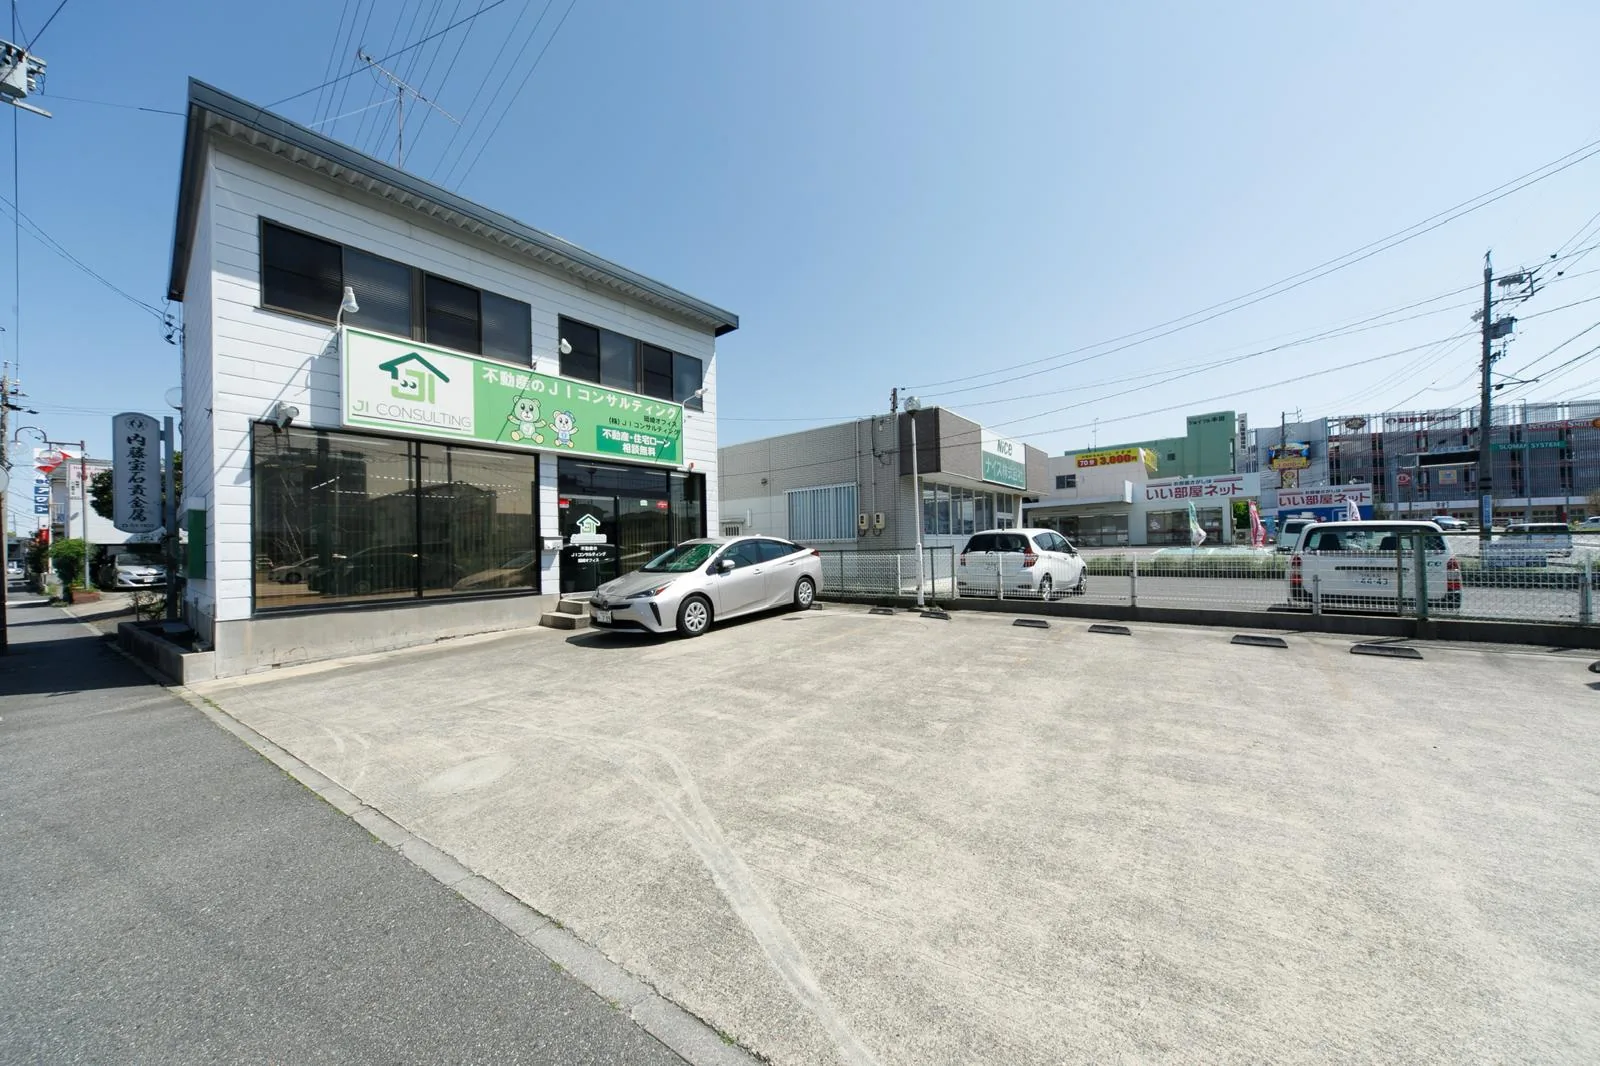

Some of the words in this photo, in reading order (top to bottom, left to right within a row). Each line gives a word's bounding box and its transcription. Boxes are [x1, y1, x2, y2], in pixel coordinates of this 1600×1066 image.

[352, 399, 370, 413] JI
[375, 402, 473, 429] CONSULTING
[622, 442, 656, 457] 相談無料
[126, 433, 148, 522] 内藤宝石貴金属
[1145, 482, 1243, 501] いい部屋ネット
[1278, 491, 1370, 506] いい部屋ネット
